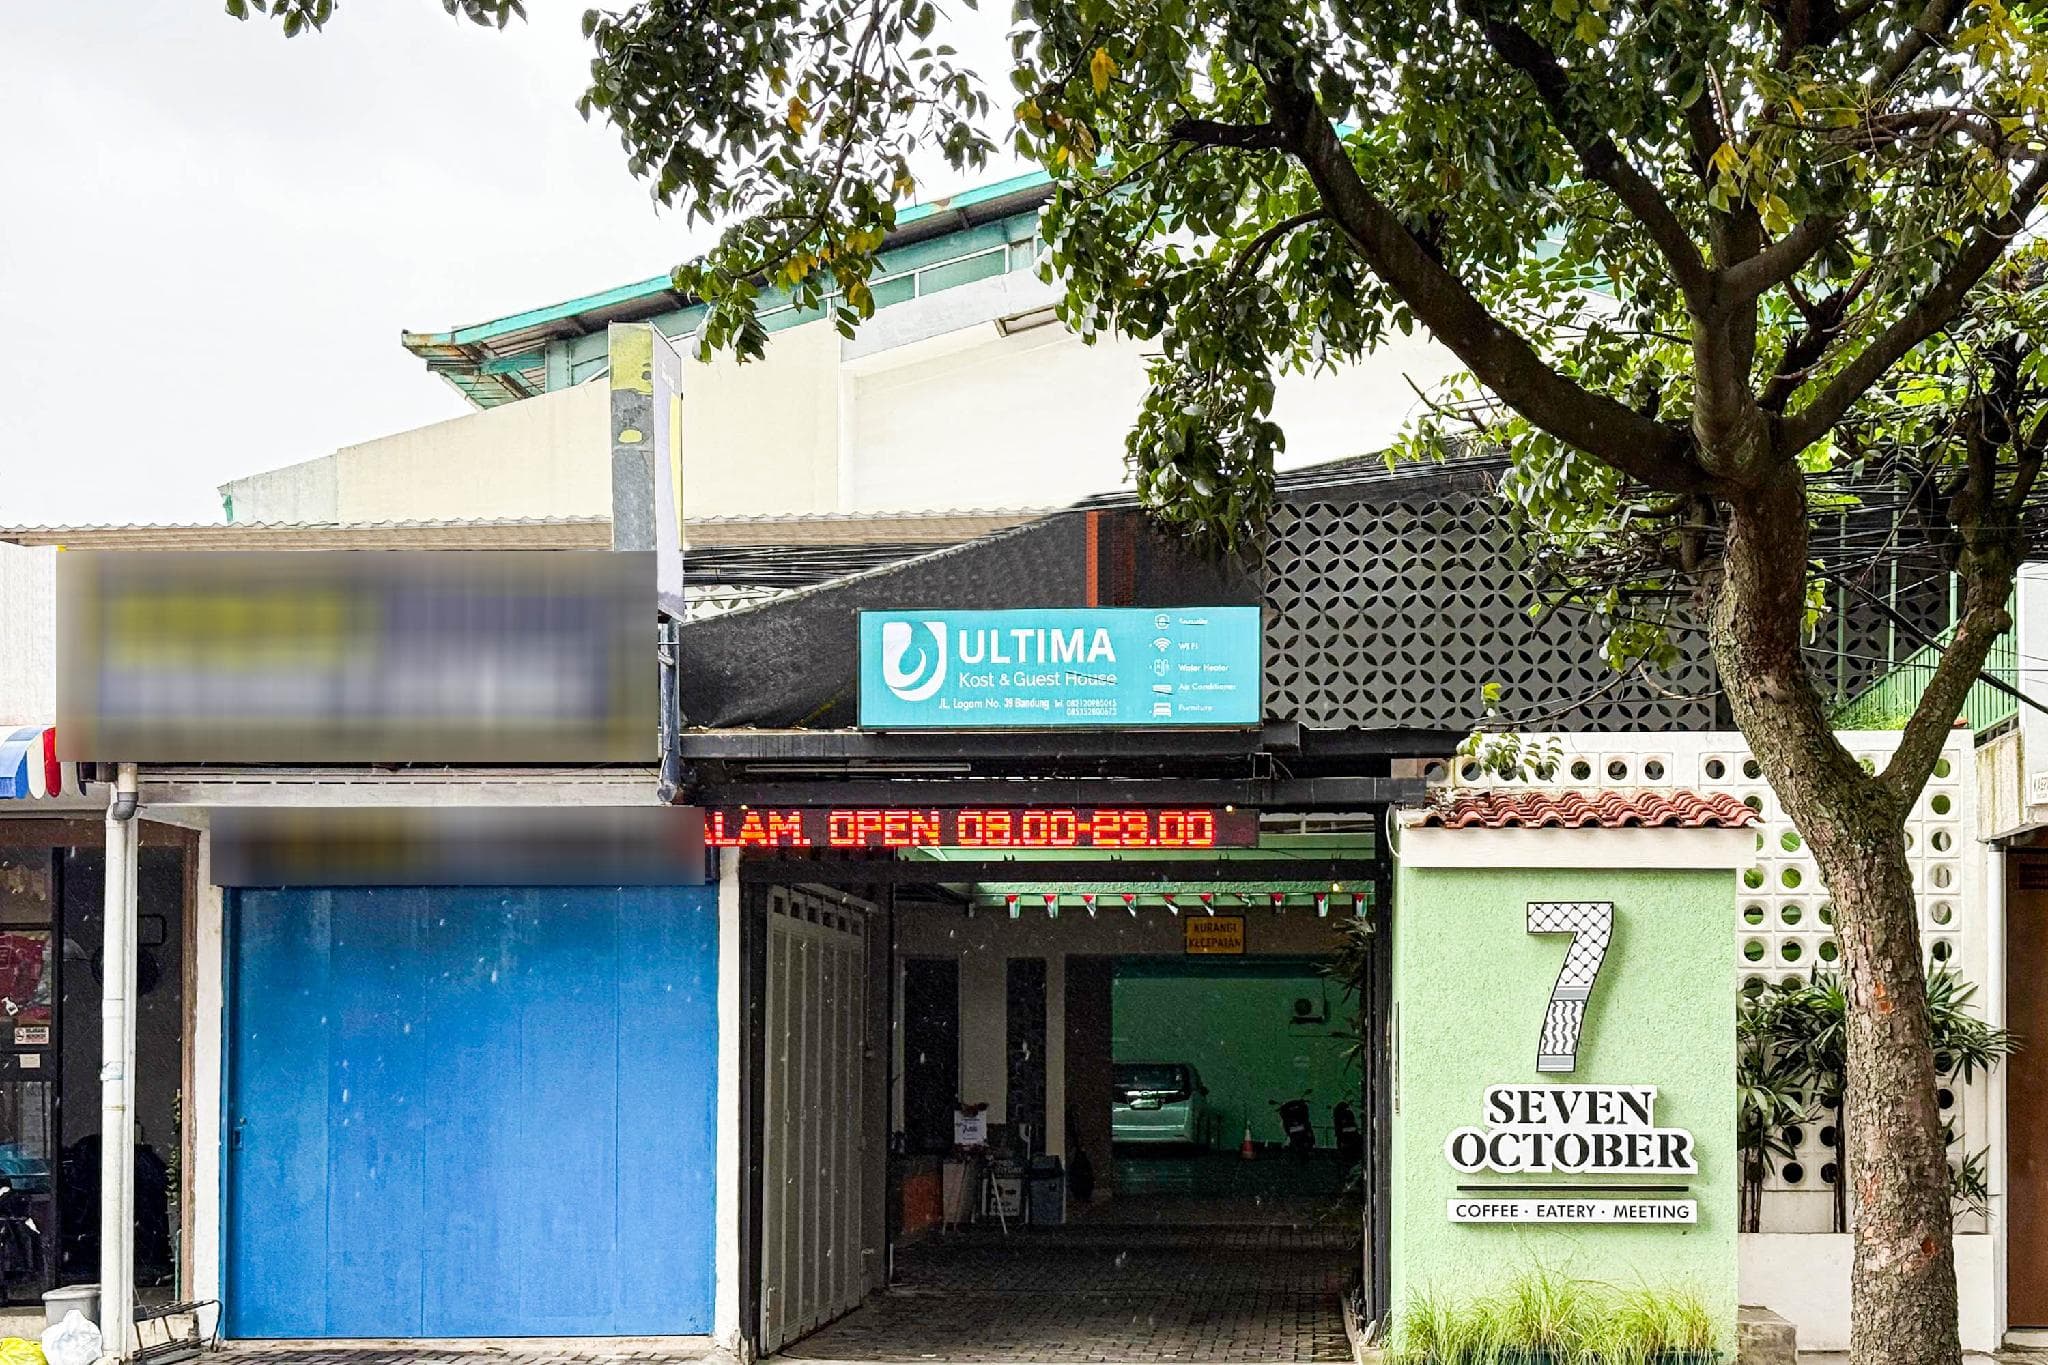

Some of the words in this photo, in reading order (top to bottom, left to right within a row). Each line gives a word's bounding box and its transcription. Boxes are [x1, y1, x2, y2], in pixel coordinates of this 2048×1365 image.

[958, 628, 1117, 664] ULTIMA
[959, 672, 995, 688] Kost
[999, 673, 1010, 687] &
[1013, 671, 1061, 687] Guest
[1065, 671, 1118, 687] House
[953, 699, 983, 711] Logam
[985, 699, 1000, 709] No.
[1015, 698, 1050, 710] Bandung
[704, 810, 811, 846] LAM.
[828, 810, 941, 846] OPEN
[1526, 901, 1614, 1073] 7
[1489, 1089, 1652, 1126] SEVEN
[1452, 1132, 1691, 1168] OCTOBER
[1456, 1204, 1518, 1218] COFFEE
[1536, 1204, 1595, 1218] EATERY
[1613, 1204, 1690, 1219] MEETING
